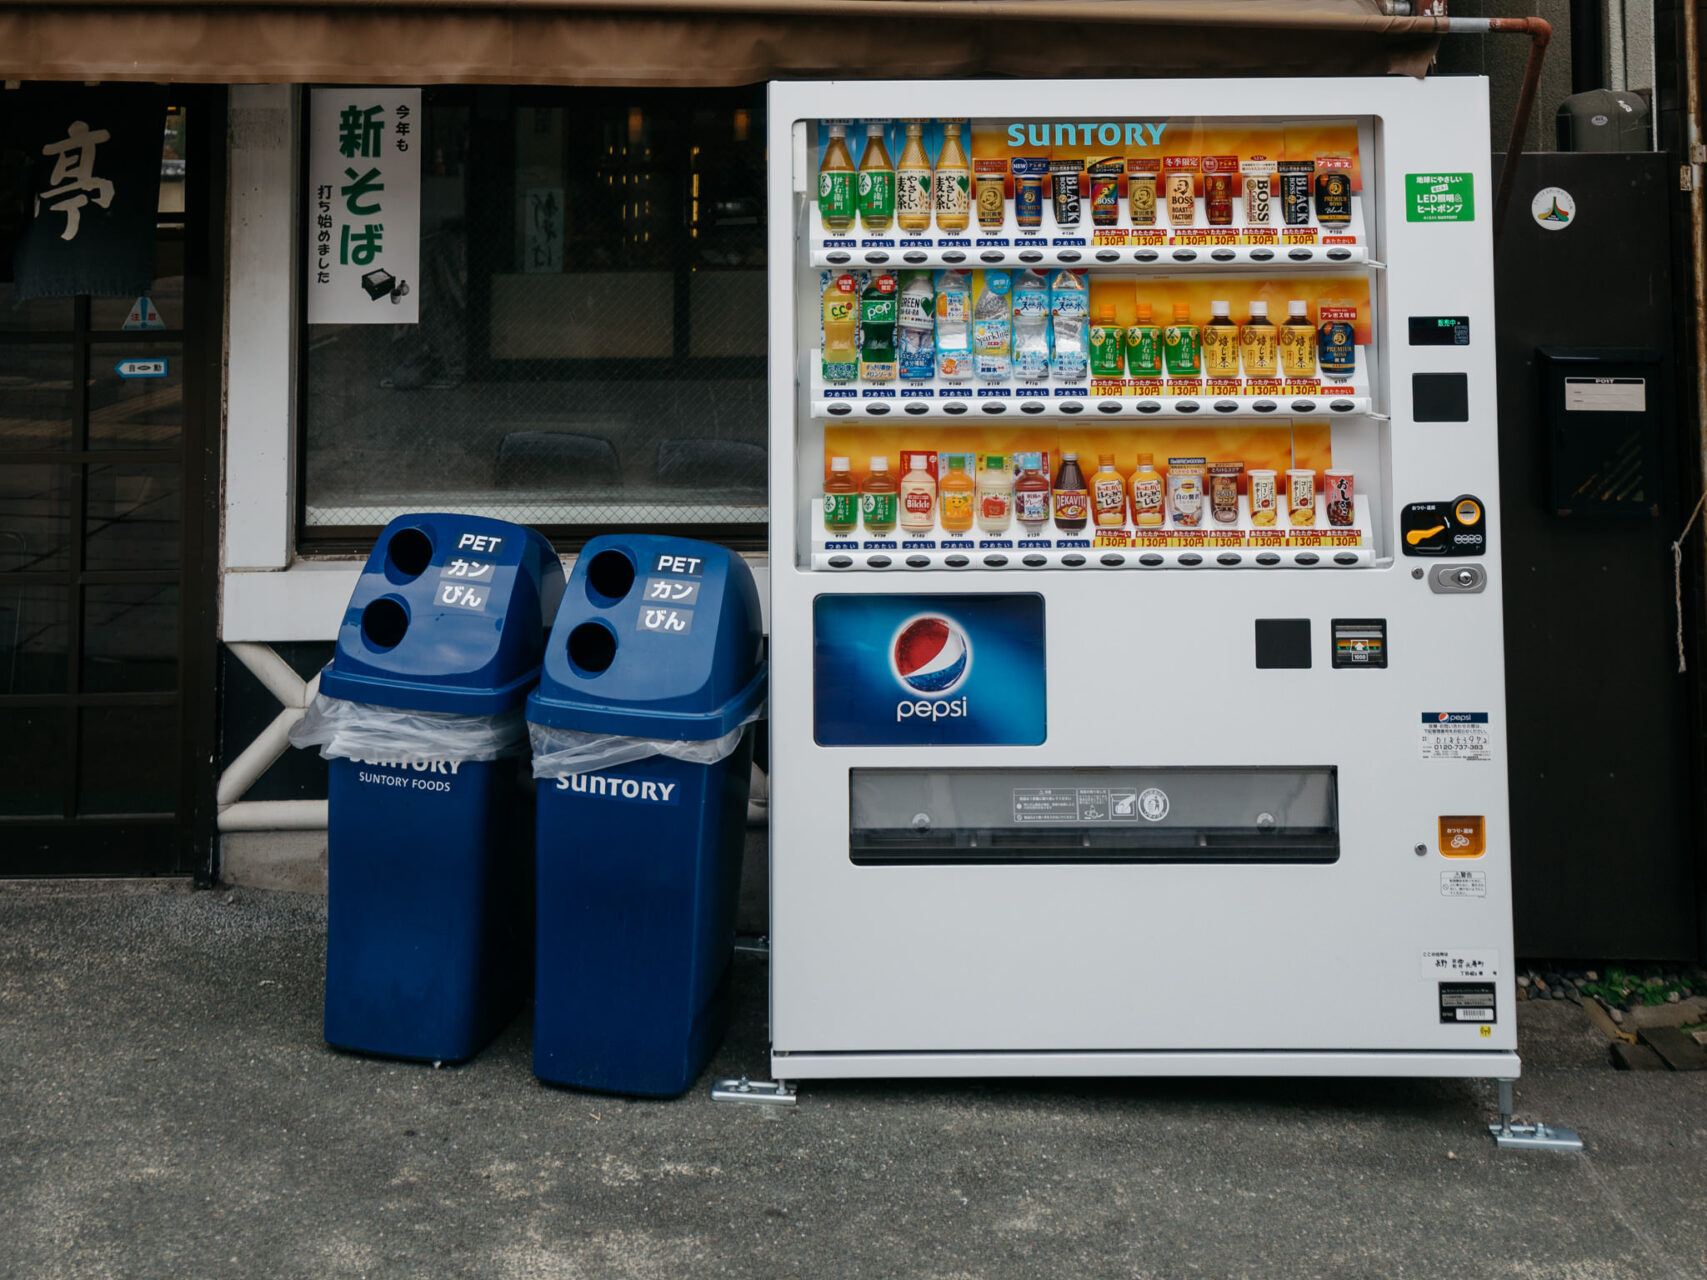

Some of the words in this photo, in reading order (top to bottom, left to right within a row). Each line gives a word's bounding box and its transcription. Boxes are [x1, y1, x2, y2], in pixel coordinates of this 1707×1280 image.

[396, 105, 410, 152] 今年も
[1007, 123, 1167, 146] SUNTORY
[34, 120, 116, 241] 亭
[339, 104, 385, 266] 新そば
[898, 177, 907, 210] 麦茶
[907, 176, 918, 209] やさしい
[936, 177, 945, 210] 麦茶
[945, 176, 956, 209] やさしい
[1066, 177, 1079, 223] BLACK
[1172, 196, 1193, 204] BOSS
[1296, 177, 1308, 224] BLACK
[1257, 180, 1269, 222] BOSS
[1417, 205, 1463, 213] ヒートポンプ
[317, 185, 332, 283] 打ち始めました
[1099, 237, 1125, 245] 130円
[1137, 237, 1163, 245] 130円
[1181, 236, 1207, 245] 130円
[1211, 236, 1236, 245] 130円
[1247, 236, 1274, 245] 130円
[1288, 236, 1314, 245] 130円
[976, 330, 1009, 346] Sparkling
[1096, 387, 1122, 396] 130円
[1134, 387, 1160, 396] 130円
[1171, 387, 1198, 396] 130円
[1211, 387, 1238, 396] 130円
[1252, 386, 1279, 395] 130円
[1290, 386, 1317, 395] 130円
[906, 499, 930, 508] Bikkle
[1338, 478, 1350, 516] おしるこ
[458, 533, 502, 552] PET
[1100, 538, 1127, 547] 130円
[1141, 538, 1167, 547] 130円
[1178, 538, 1205, 547] 130円
[1215, 538, 1241, 547] 130円
[1255, 537, 1281, 546] 130円
[1294, 537, 1321, 546] 130円
[1331, 537, 1357, 546] 130円
[448, 559, 490, 577] カン
[657, 555, 701, 574] PET
[442, 585, 482, 607] びん
[651, 581, 694, 600] カン
[645, 609, 686, 631] びん
[897, 696, 967, 722] pepsi
[359, 771, 409, 787] SUNTORY
[412, 779, 451, 792] FOODS
[556, 771, 676, 801] SUNTORY
